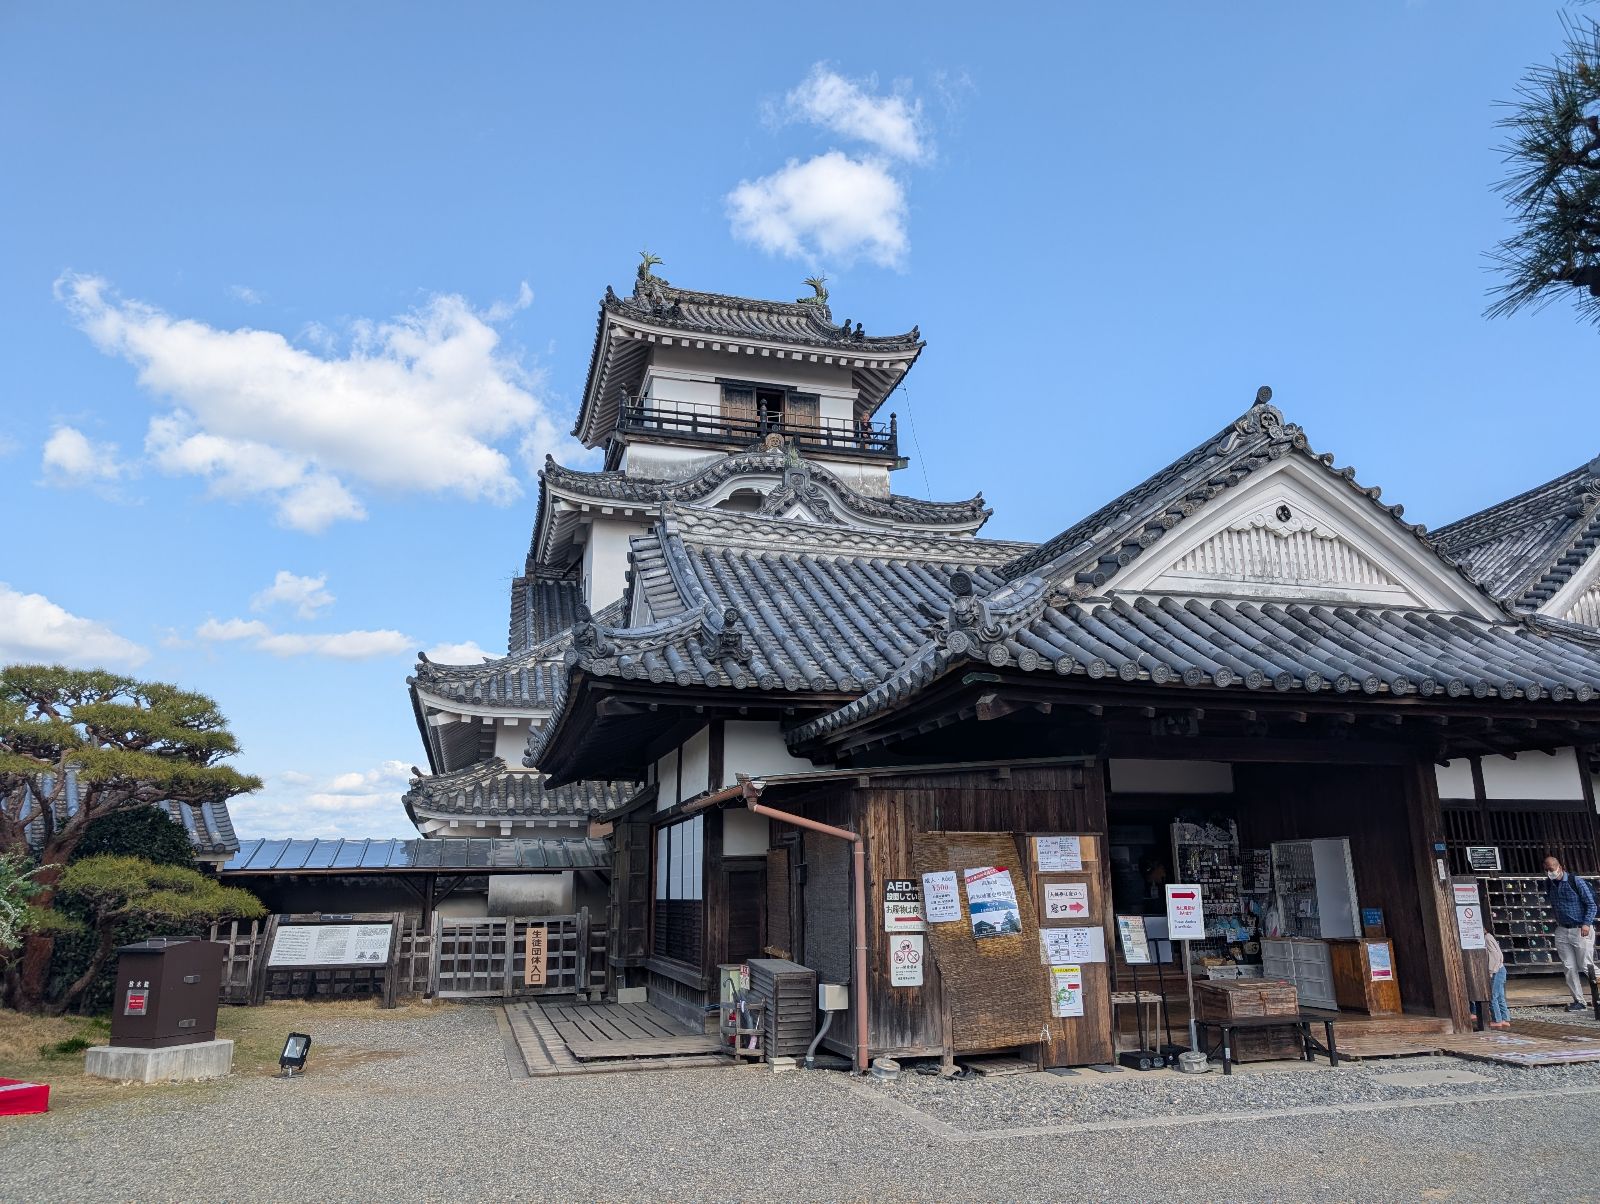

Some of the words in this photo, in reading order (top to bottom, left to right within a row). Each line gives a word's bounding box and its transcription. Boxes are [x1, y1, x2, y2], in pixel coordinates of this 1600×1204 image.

[530, 930, 542, 982] 生徒団体入口
